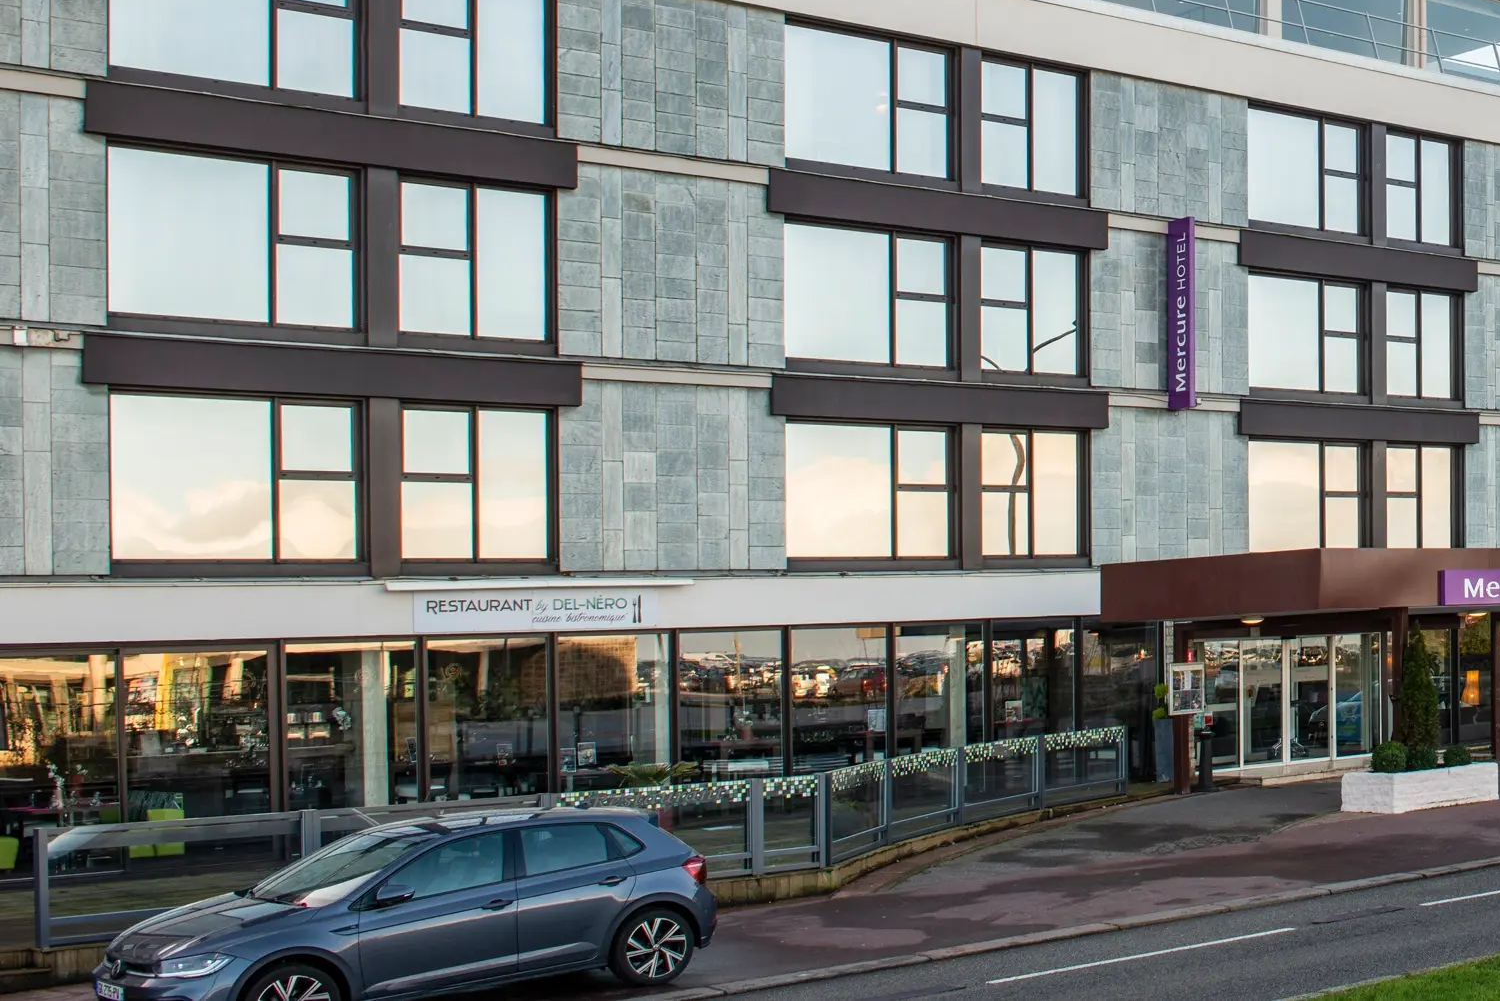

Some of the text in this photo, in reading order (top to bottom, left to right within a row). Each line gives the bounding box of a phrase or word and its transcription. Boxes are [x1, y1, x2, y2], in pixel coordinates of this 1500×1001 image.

[1176, 231, 1187, 393] Mercure HOTEL
[426, 595, 628, 614] RESTAURANT by DEL-NÉRO
[532, 614, 562, 624] cuisine
